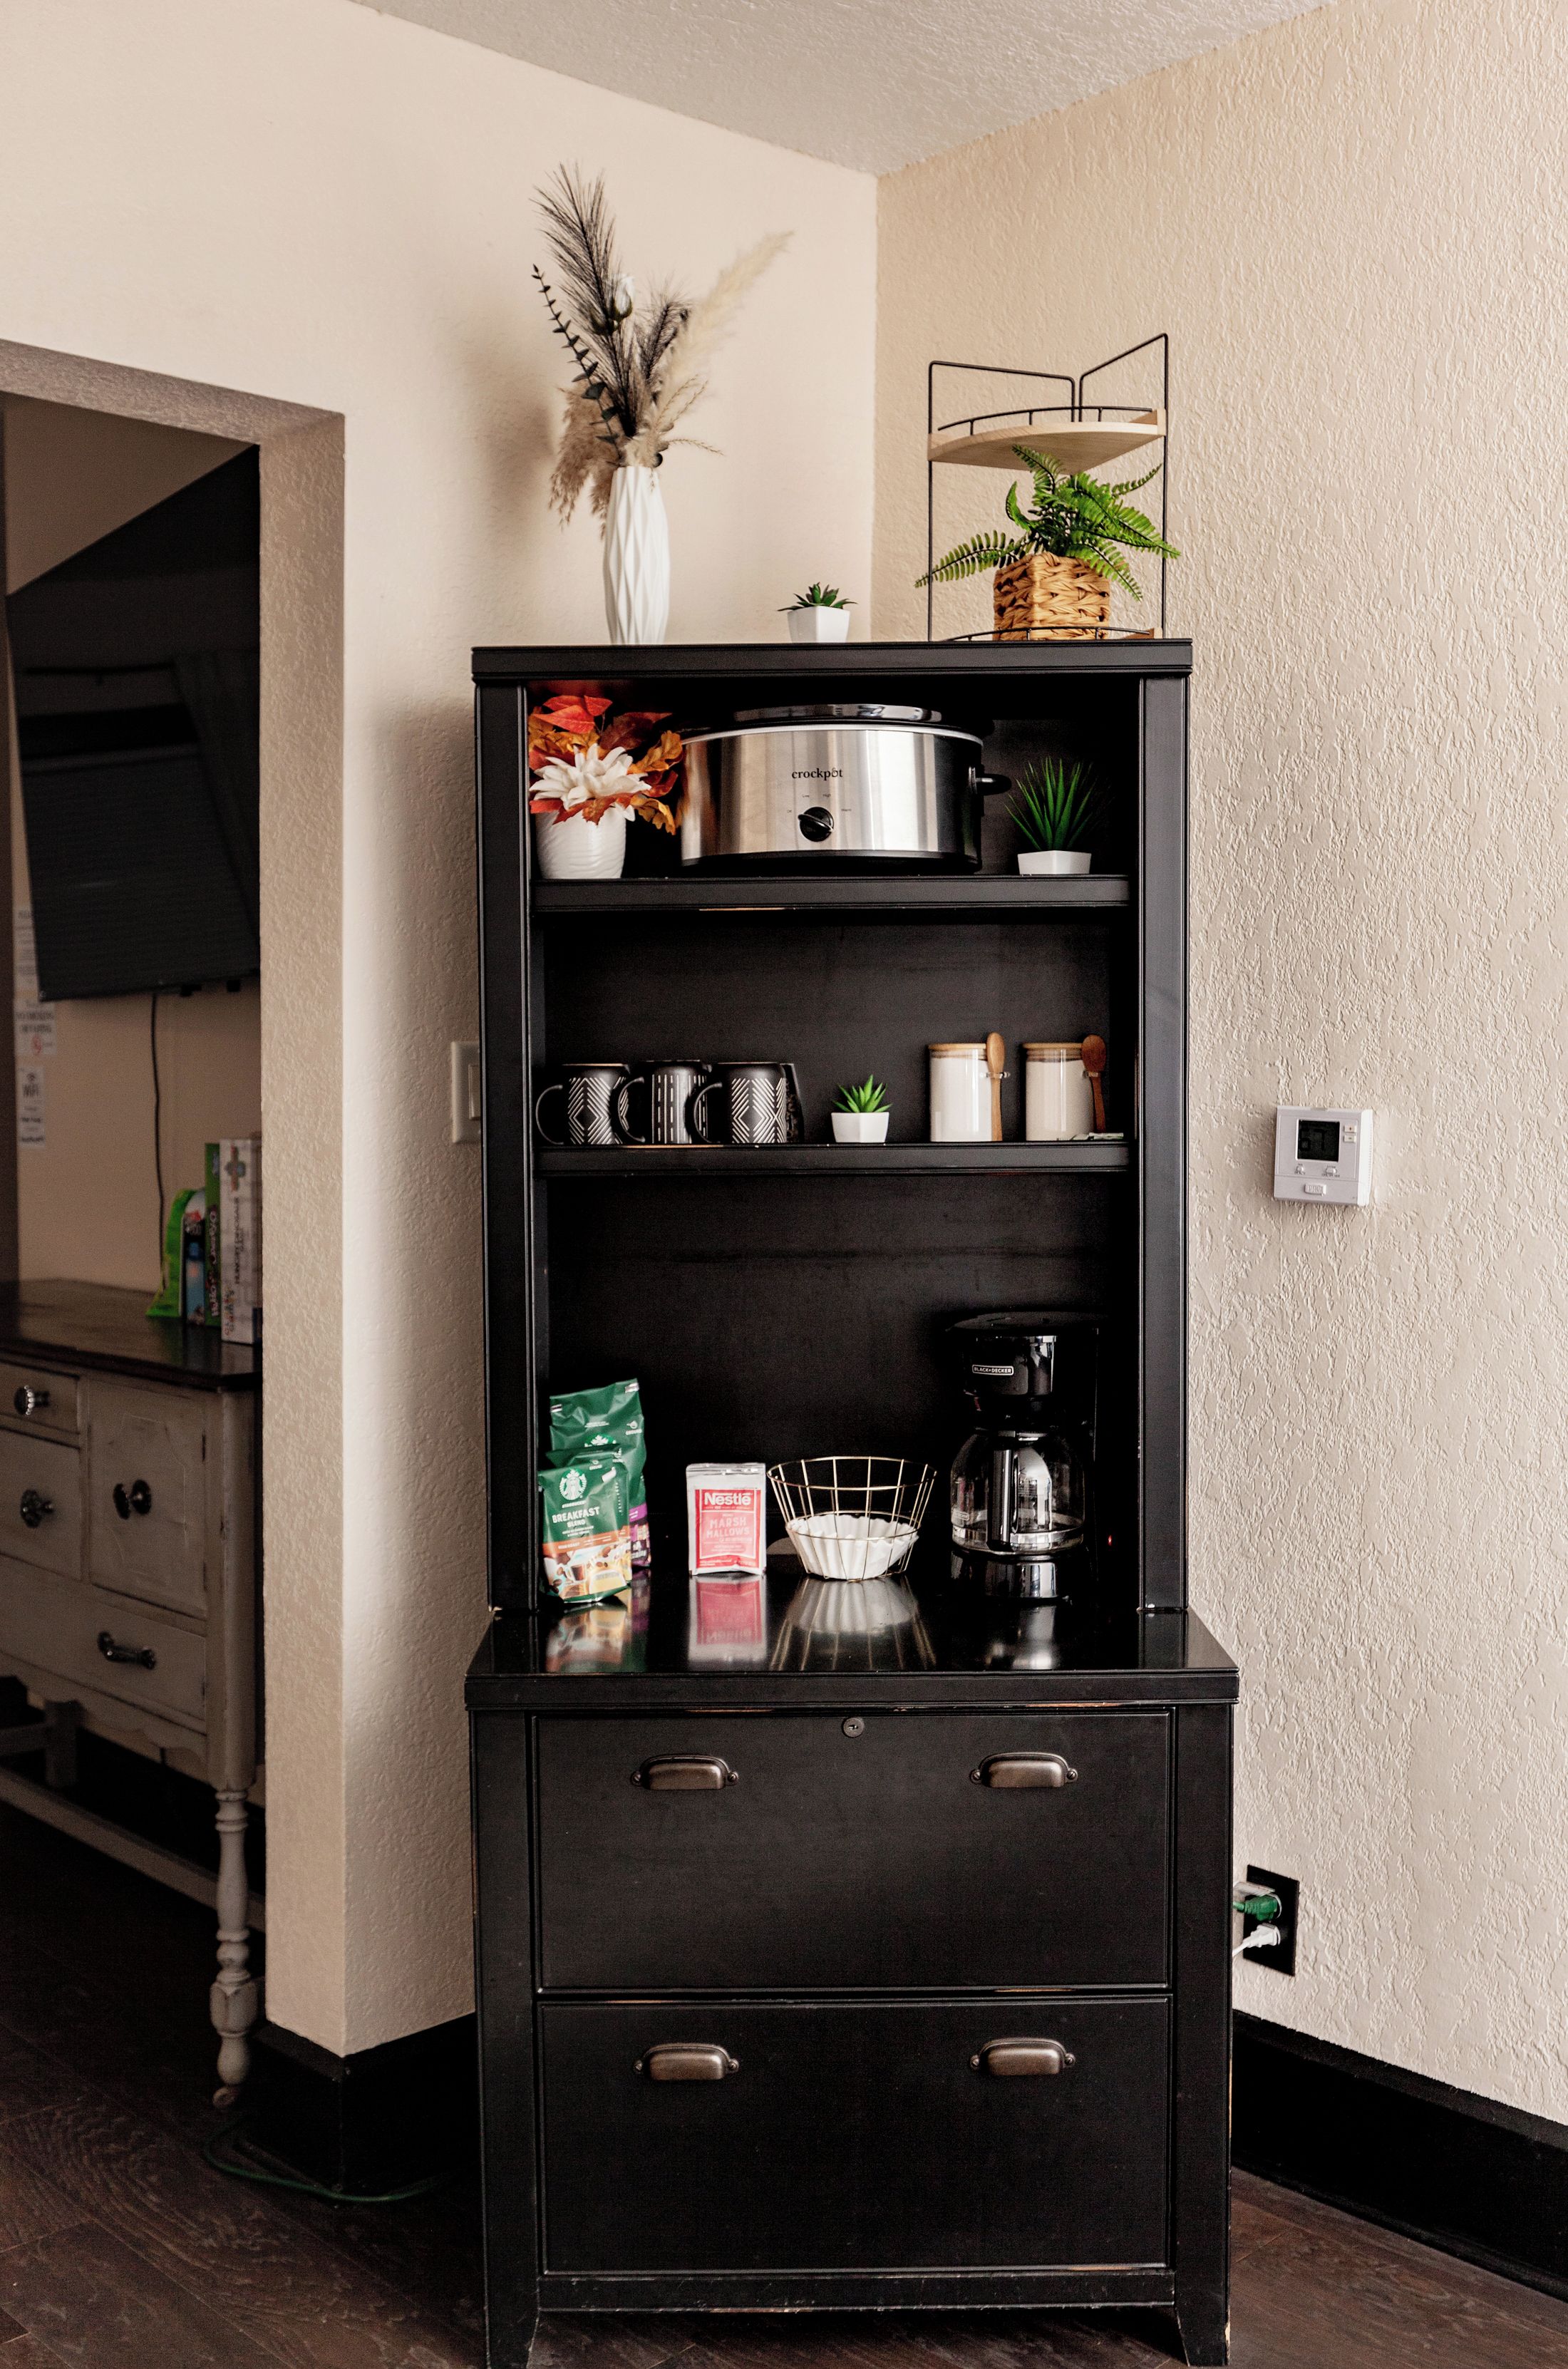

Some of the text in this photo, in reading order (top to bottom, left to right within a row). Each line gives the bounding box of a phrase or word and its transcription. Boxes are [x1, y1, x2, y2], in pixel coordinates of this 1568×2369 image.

[792, 767, 843, 781] crockpot
[704, 1492, 753, 1506] Nestlé
[552, 1506, 600, 1524] BREAKFAST
[567, 1519, 586, 1528] BLEND
[710, 1517, 747, 1529] MARSH
[706, 1527, 750, 1539] MALLOWS
